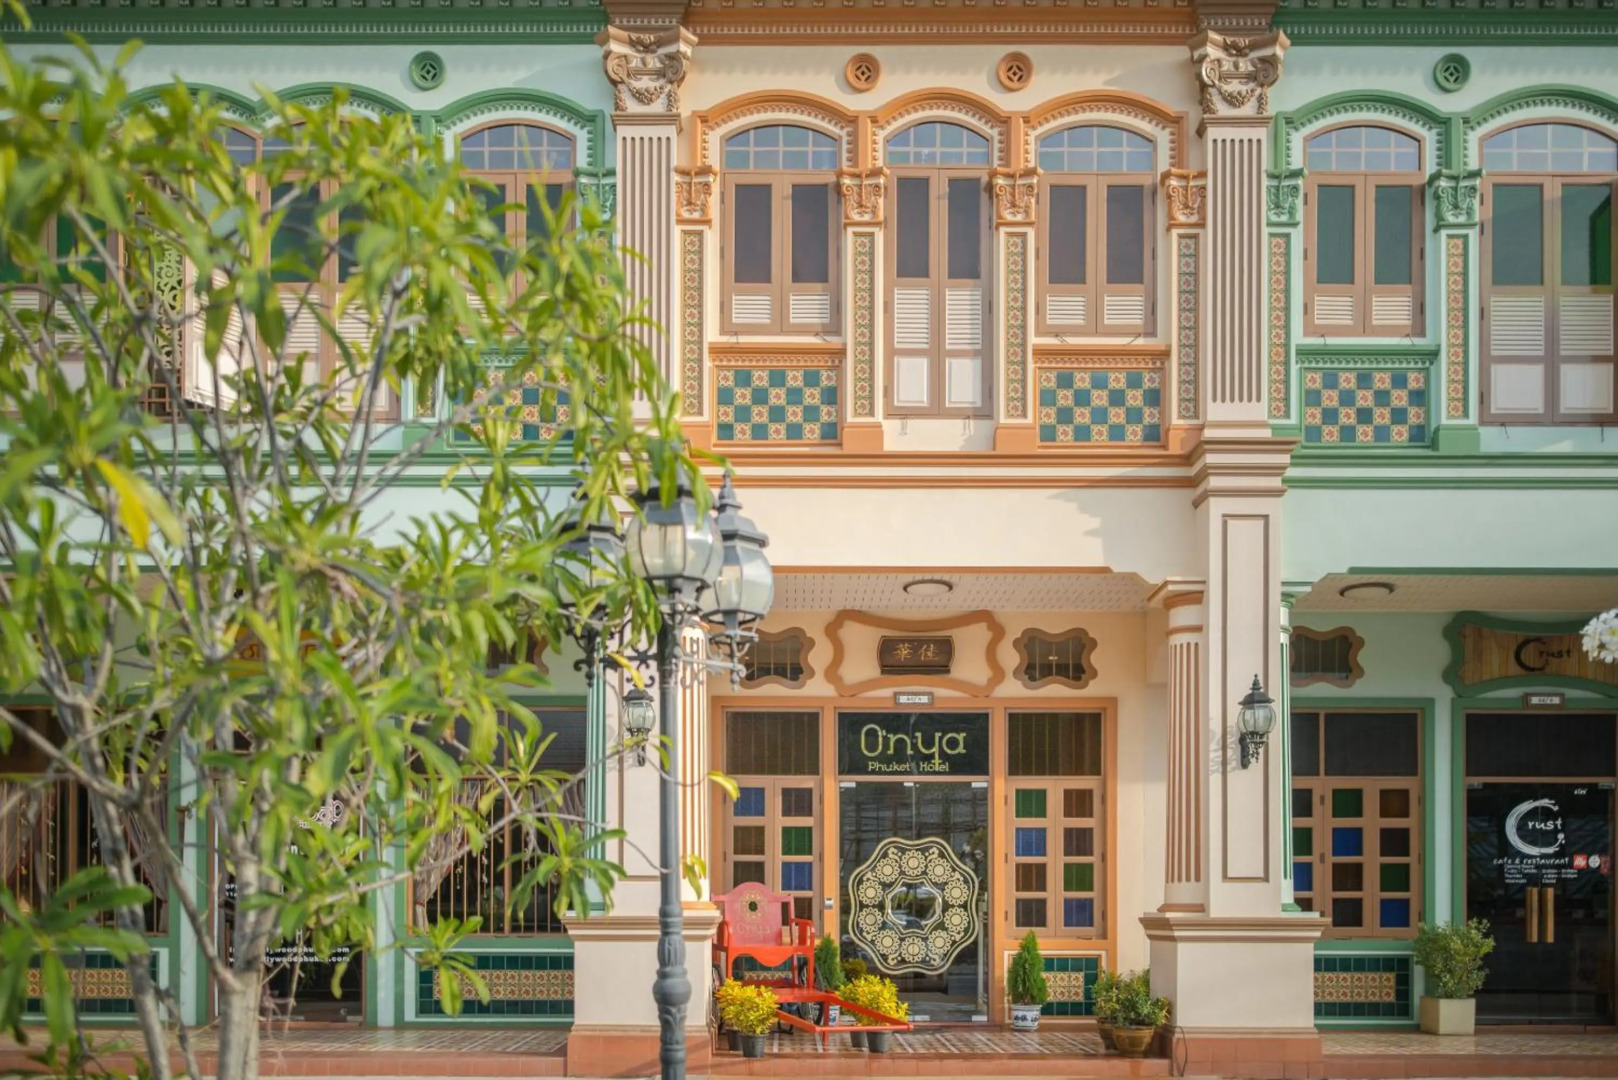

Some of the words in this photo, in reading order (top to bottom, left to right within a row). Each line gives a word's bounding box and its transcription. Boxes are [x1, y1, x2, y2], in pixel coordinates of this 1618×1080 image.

[1514, 637, 1572, 672] Crust
[868, 761, 910, 772] Phuket
[920, 761, 949, 772] Hotel
[1505, 799, 1565, 856] Crust
[1523, 857, 1569, 865] restaurant
